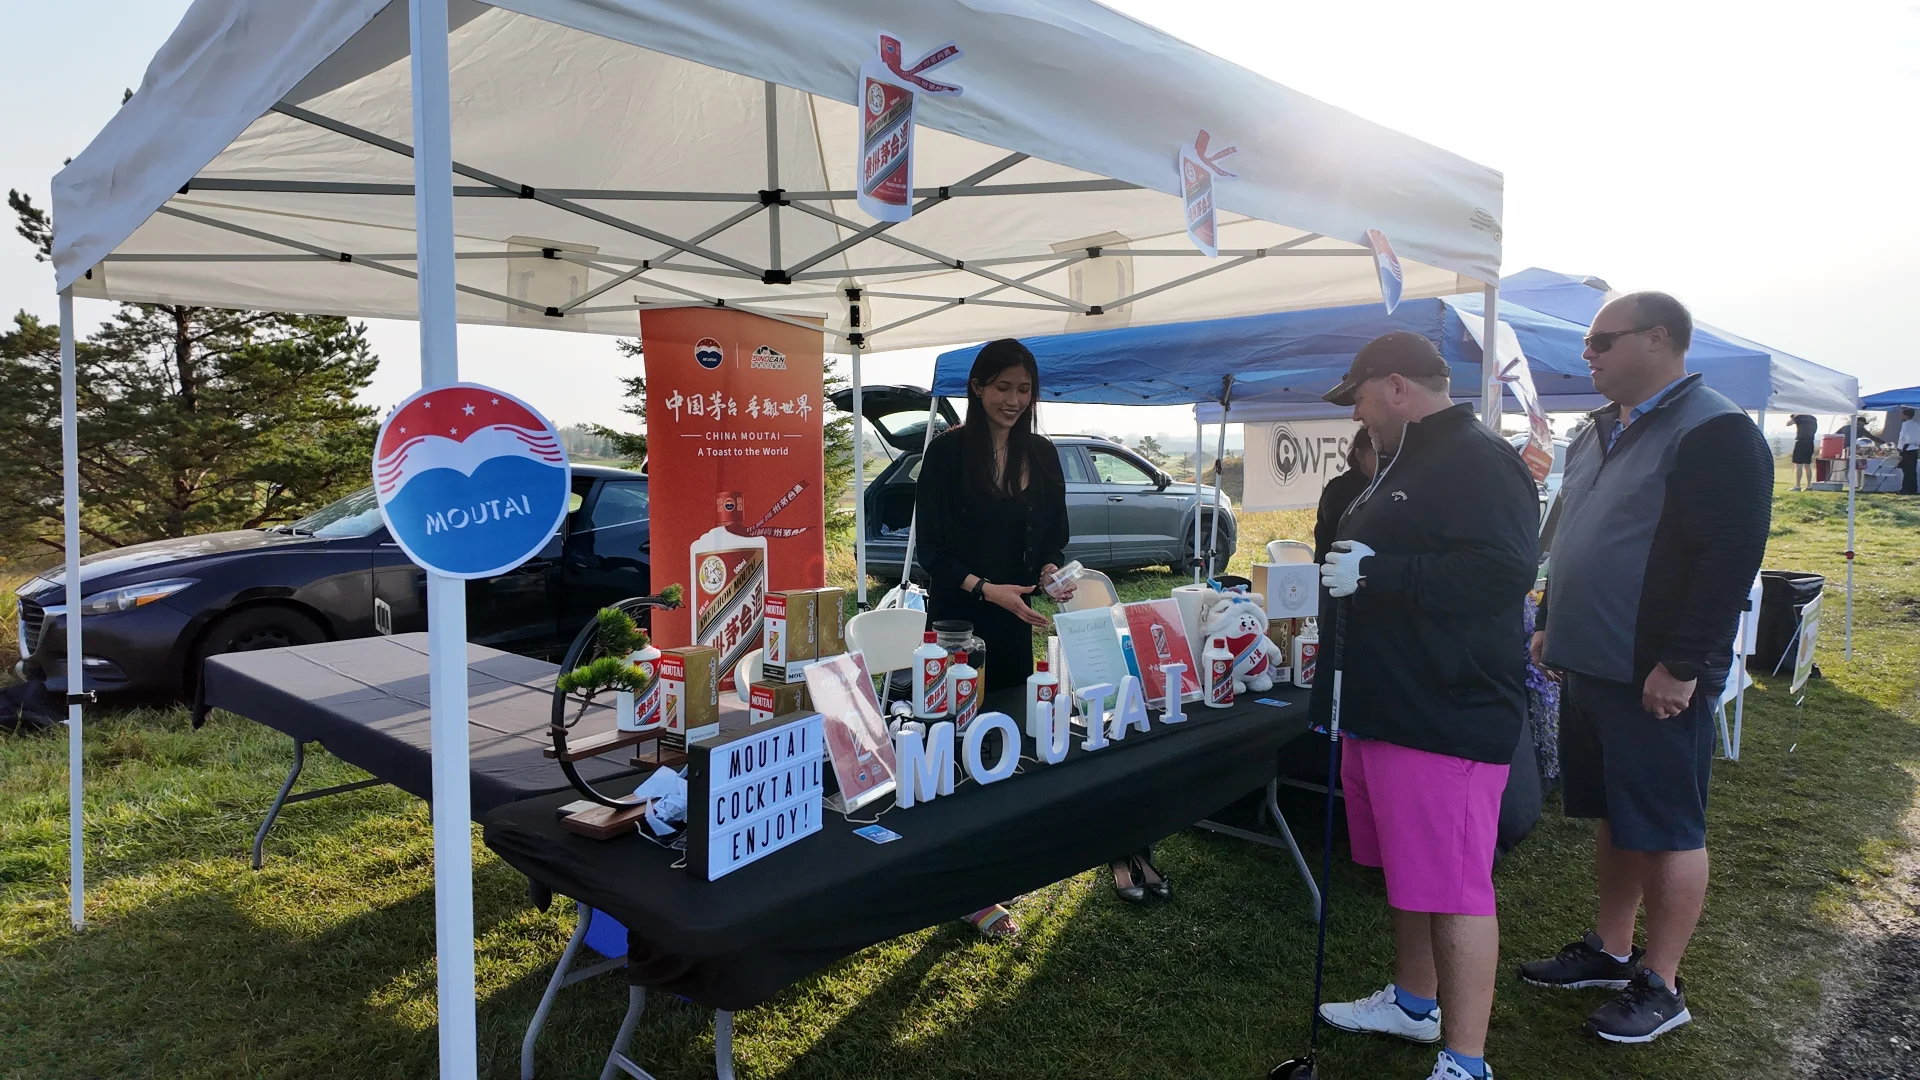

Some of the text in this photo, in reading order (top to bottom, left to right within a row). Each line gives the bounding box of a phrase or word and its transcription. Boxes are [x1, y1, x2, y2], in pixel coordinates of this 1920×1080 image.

[865, 119, 909, 184] 贵州茅台酒
[665, 389, 738, 422] 中国茅台
[698, 447, 789, 456] A Toast to the World
[705, 432, 781, 441] CHINA MOUTAI
[426, 494, 532, 536] MOUTAI
[765, 604, 786, 616] MOUTAI
[660, 663, 684, 678] MOUTAI
[751, 695, 773, 709] MOUTAI
[728, 727, 806, 780] MOUTAI
[896, 663, 1188, 809] MOUTAI
[716, 760, 820, 825] COCKTAIL
[732, 802, 809, 861] ENJOY!
